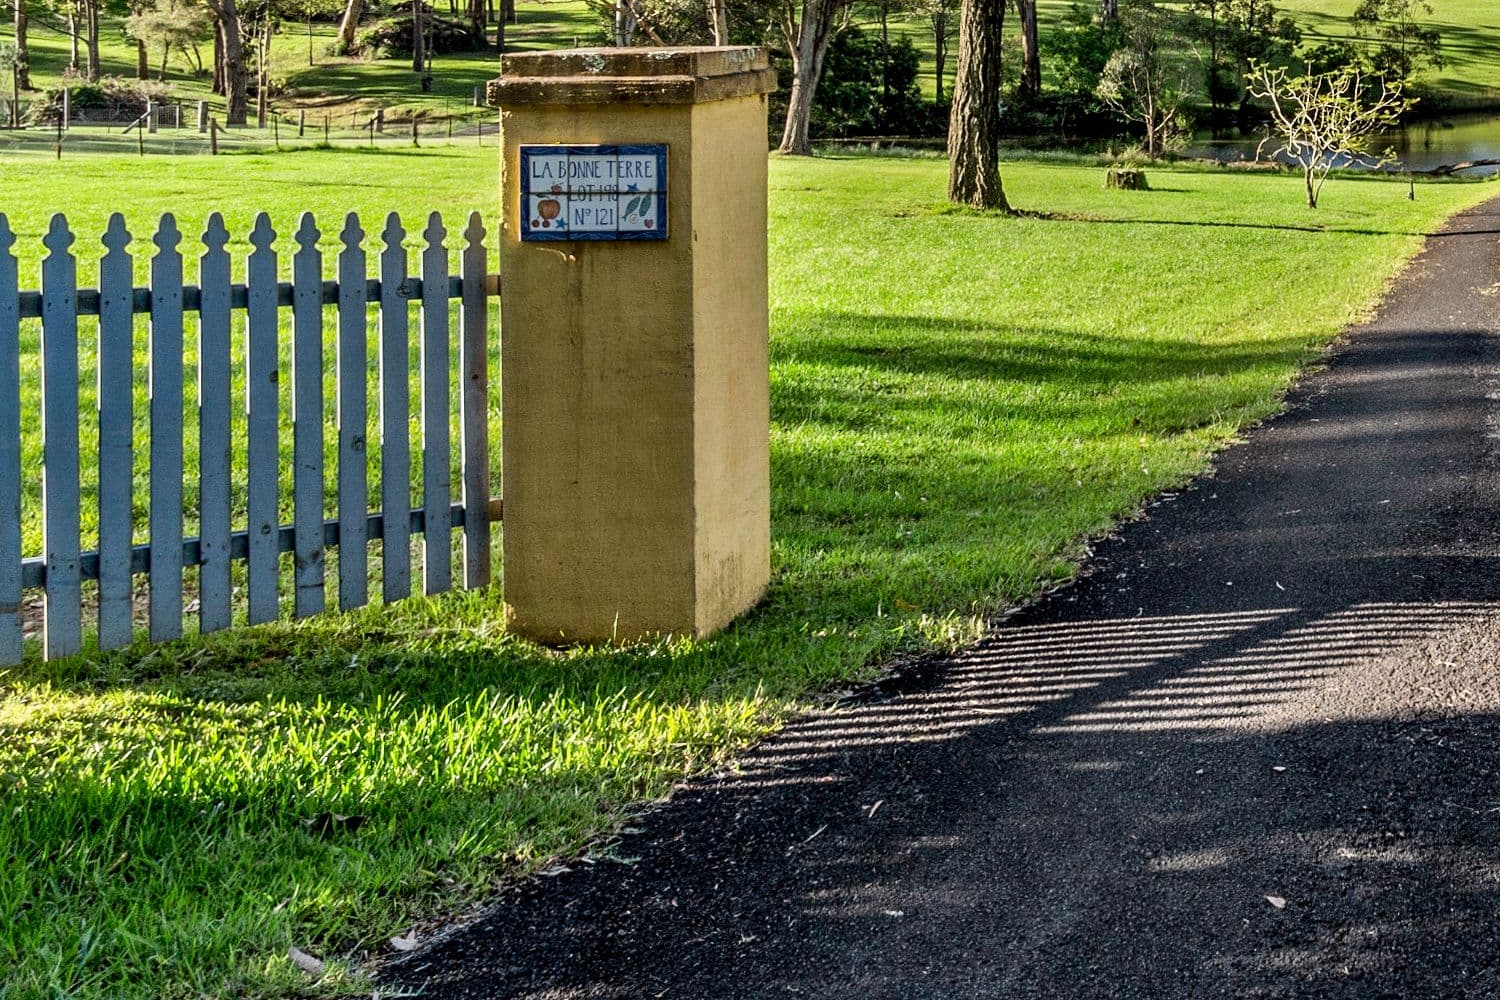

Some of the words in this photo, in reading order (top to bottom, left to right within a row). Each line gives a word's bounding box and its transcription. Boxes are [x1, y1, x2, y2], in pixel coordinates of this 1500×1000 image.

[532, 160, 553, 179] LA
[559, 160, 602, 179] BONNE
[606, 160, 653, 179] TERRE
[568, 184, 595, 202] LOT
[595, 207, 613, 225] 121
